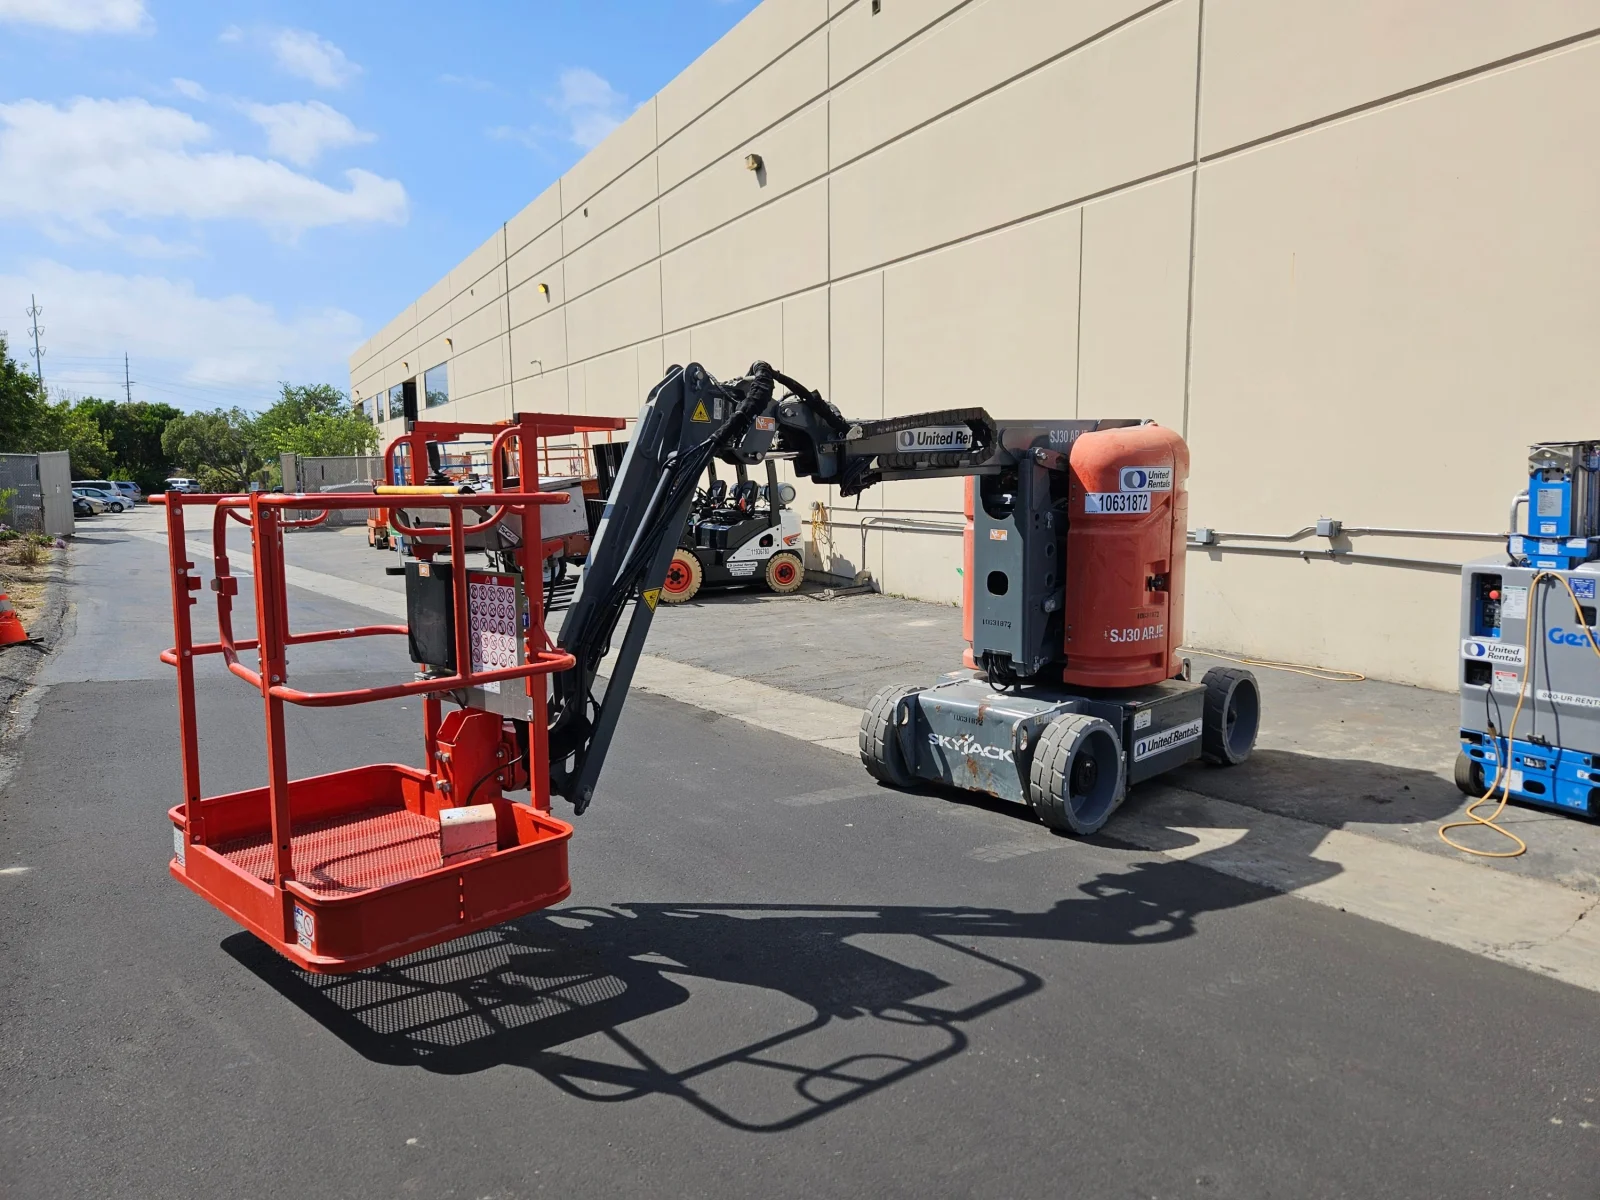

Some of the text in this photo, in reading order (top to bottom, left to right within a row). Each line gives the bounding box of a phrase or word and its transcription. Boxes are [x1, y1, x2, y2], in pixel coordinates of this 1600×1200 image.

[917, 431, 953, 446] United
[1050, 429, 1069, 443] SJ30
[1148, 470, 1170, 480] United
[1147, 480, 1171, 489] Rentals
[1099, 494, 1148, 511] 10631872
[1109, 628, 1140, 643] SJ30
[1487, 645, 1520, 656] United
[1487, 652, 1522, 664] Rentals
[1147, 724, 1200, 751] United Rentals
[927, 732, 1015, 763] SKYJACK
